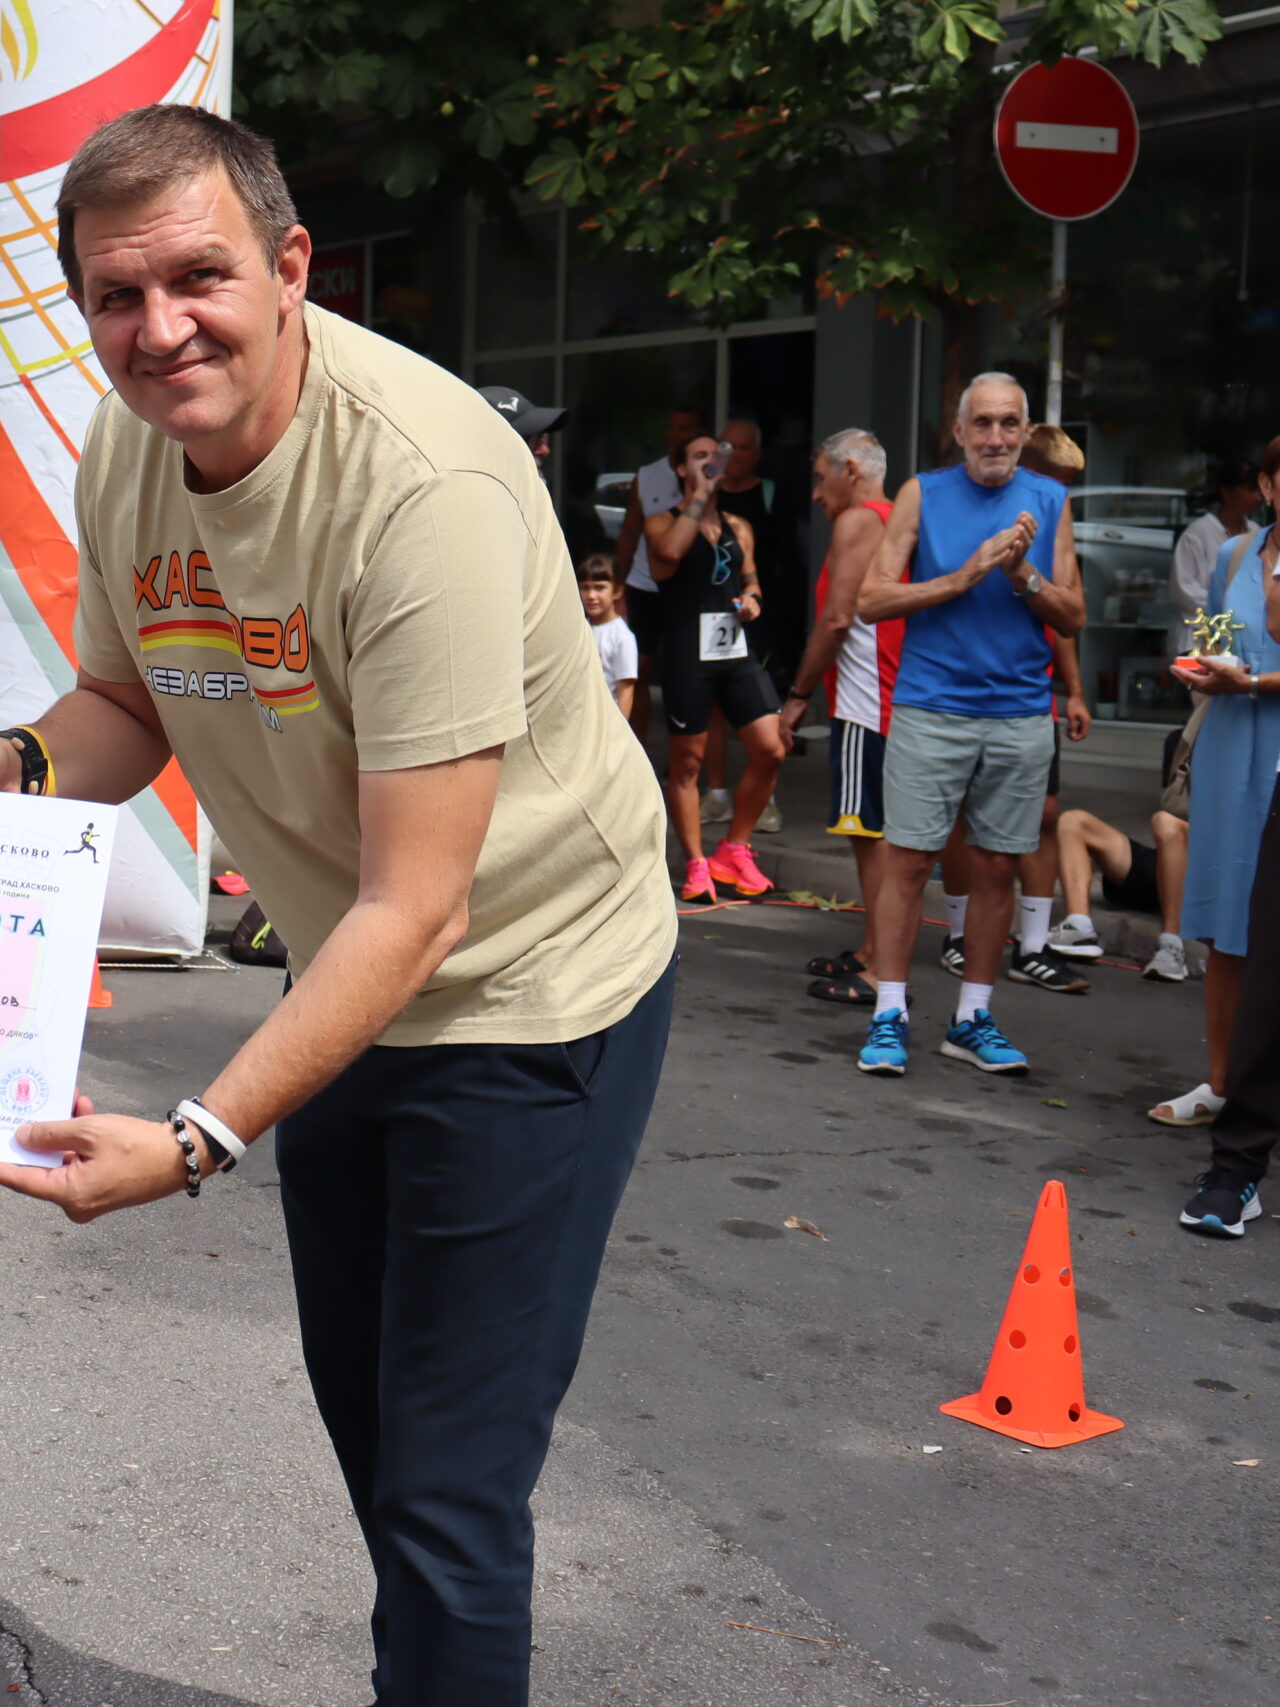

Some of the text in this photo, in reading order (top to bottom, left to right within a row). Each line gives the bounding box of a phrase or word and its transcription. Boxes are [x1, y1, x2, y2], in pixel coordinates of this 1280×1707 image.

[716, 626, 738, 646] 21
[20, 881, 60, 893] ХАСКОВО
[3, 891, 30, 900] година
